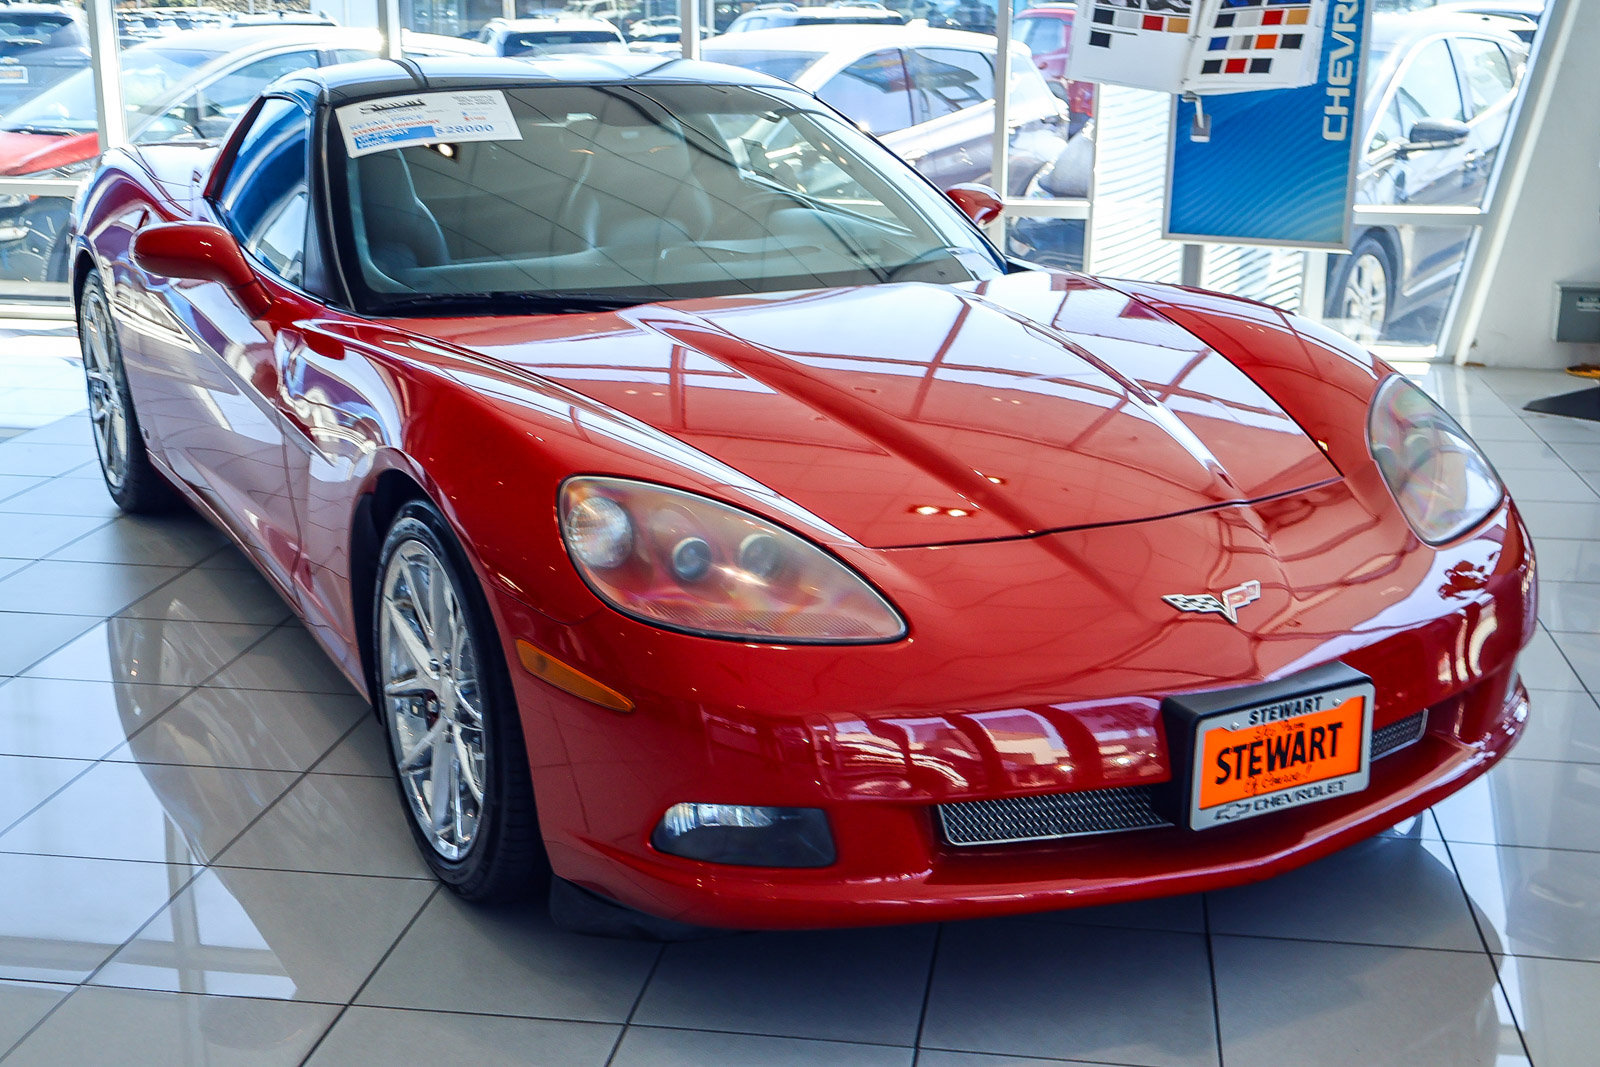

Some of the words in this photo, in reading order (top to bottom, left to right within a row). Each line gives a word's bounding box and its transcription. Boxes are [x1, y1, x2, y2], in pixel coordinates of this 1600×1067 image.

[1322, 0, 1359, 141] CHEVR
[435, 123, 495, 135] $28000
[1248, 696, 1324, 726] STEWART
[1215, 721, 1344, 785] STEWART
[1254, 780, 1348, 811] CHEVROLET
